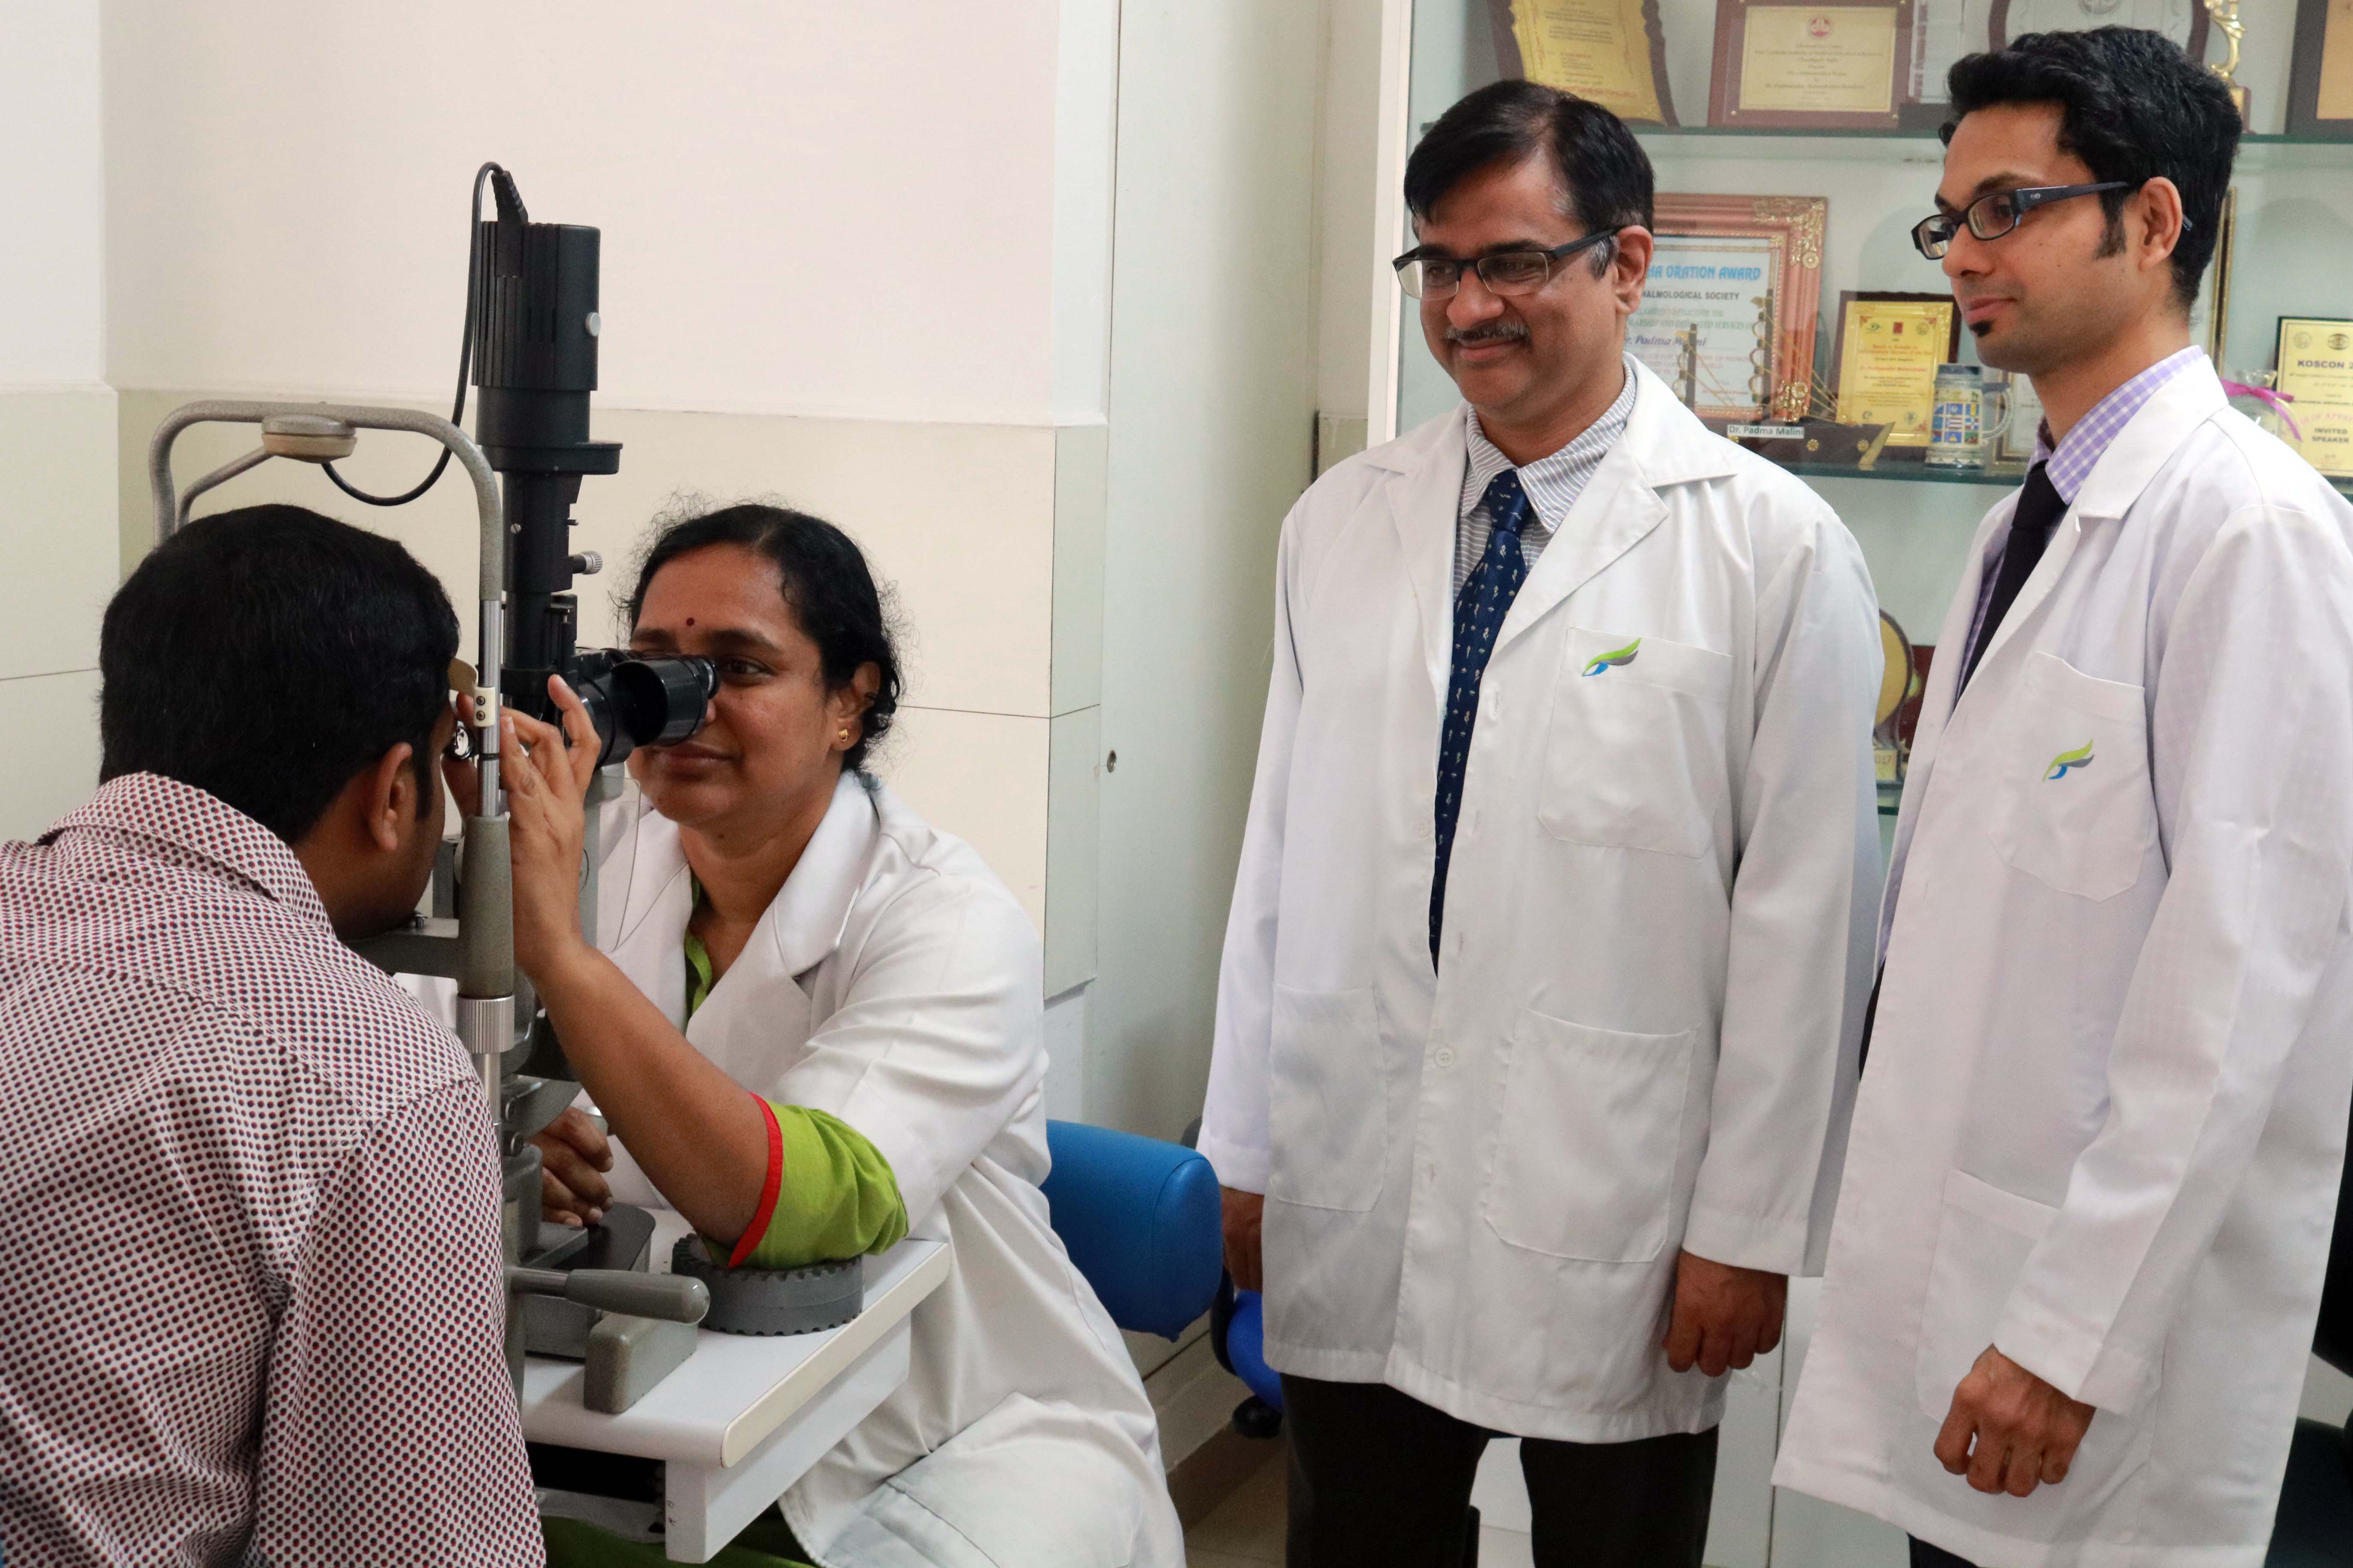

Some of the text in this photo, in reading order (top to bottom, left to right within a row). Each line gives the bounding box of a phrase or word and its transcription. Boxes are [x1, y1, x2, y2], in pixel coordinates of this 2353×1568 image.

[1666, 266, 1715, 280] ORATION
[1719, 267, 1761, 281] AWARD
[1642, 290, 1739, 300] HALMOLOGICAL SOCIETY
[1635, 335, 1671, 345] Padma
[2297, 360, 2344, 369] KOSCON
[1744, 426, 1773, 435] Padma
[1875, 755, 1892, 764] 017
